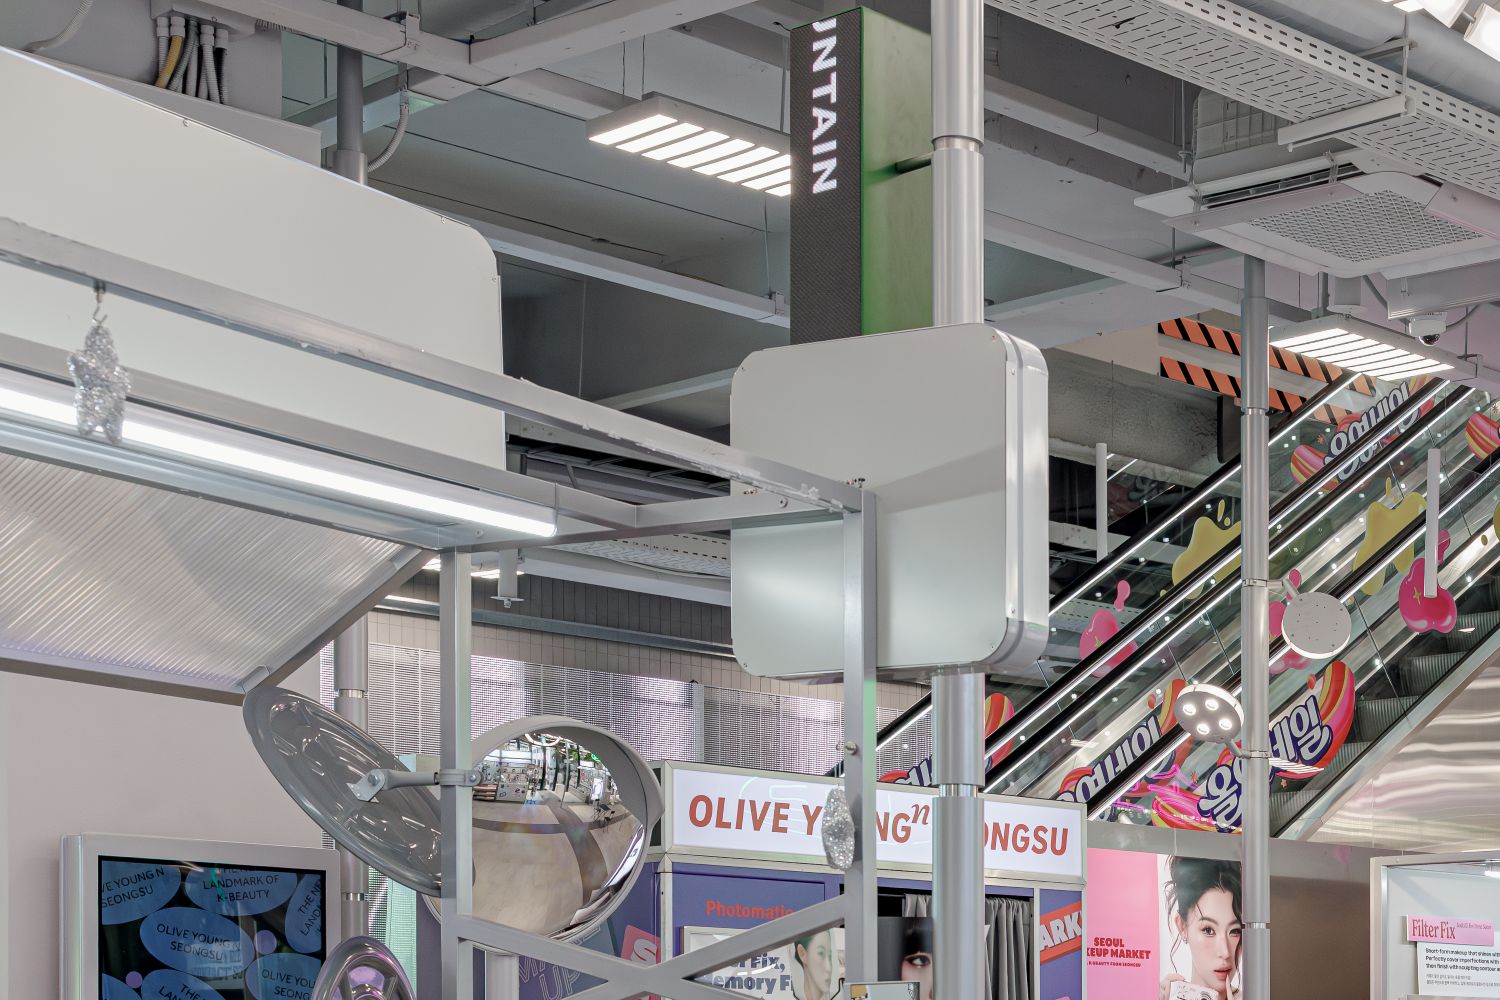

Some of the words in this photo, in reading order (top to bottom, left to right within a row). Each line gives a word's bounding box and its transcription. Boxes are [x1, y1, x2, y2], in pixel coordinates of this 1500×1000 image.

[688, 794, 789, 834] OLIVE
[801, 803, 931, 844] YNGn
[203, 876, 264, 890] LANDMARK
[266, 875, 280, 885] OF
[217, 889, 270, 903] K-BEAUTY
[156, 923, 190, 940] OLIVE
[189, 931, 231, 948] YOUNG
[1412, 919, 1439, 939] Filter
[1440, 921, 1456, 940] Fix
[1094, 937, 1125, 948] SEOUL
[170, 941, 223, 961] SEONGSU
[1110, 949, 1151, 960] MARKET
[261, 969, 293, 983] OLIVE
